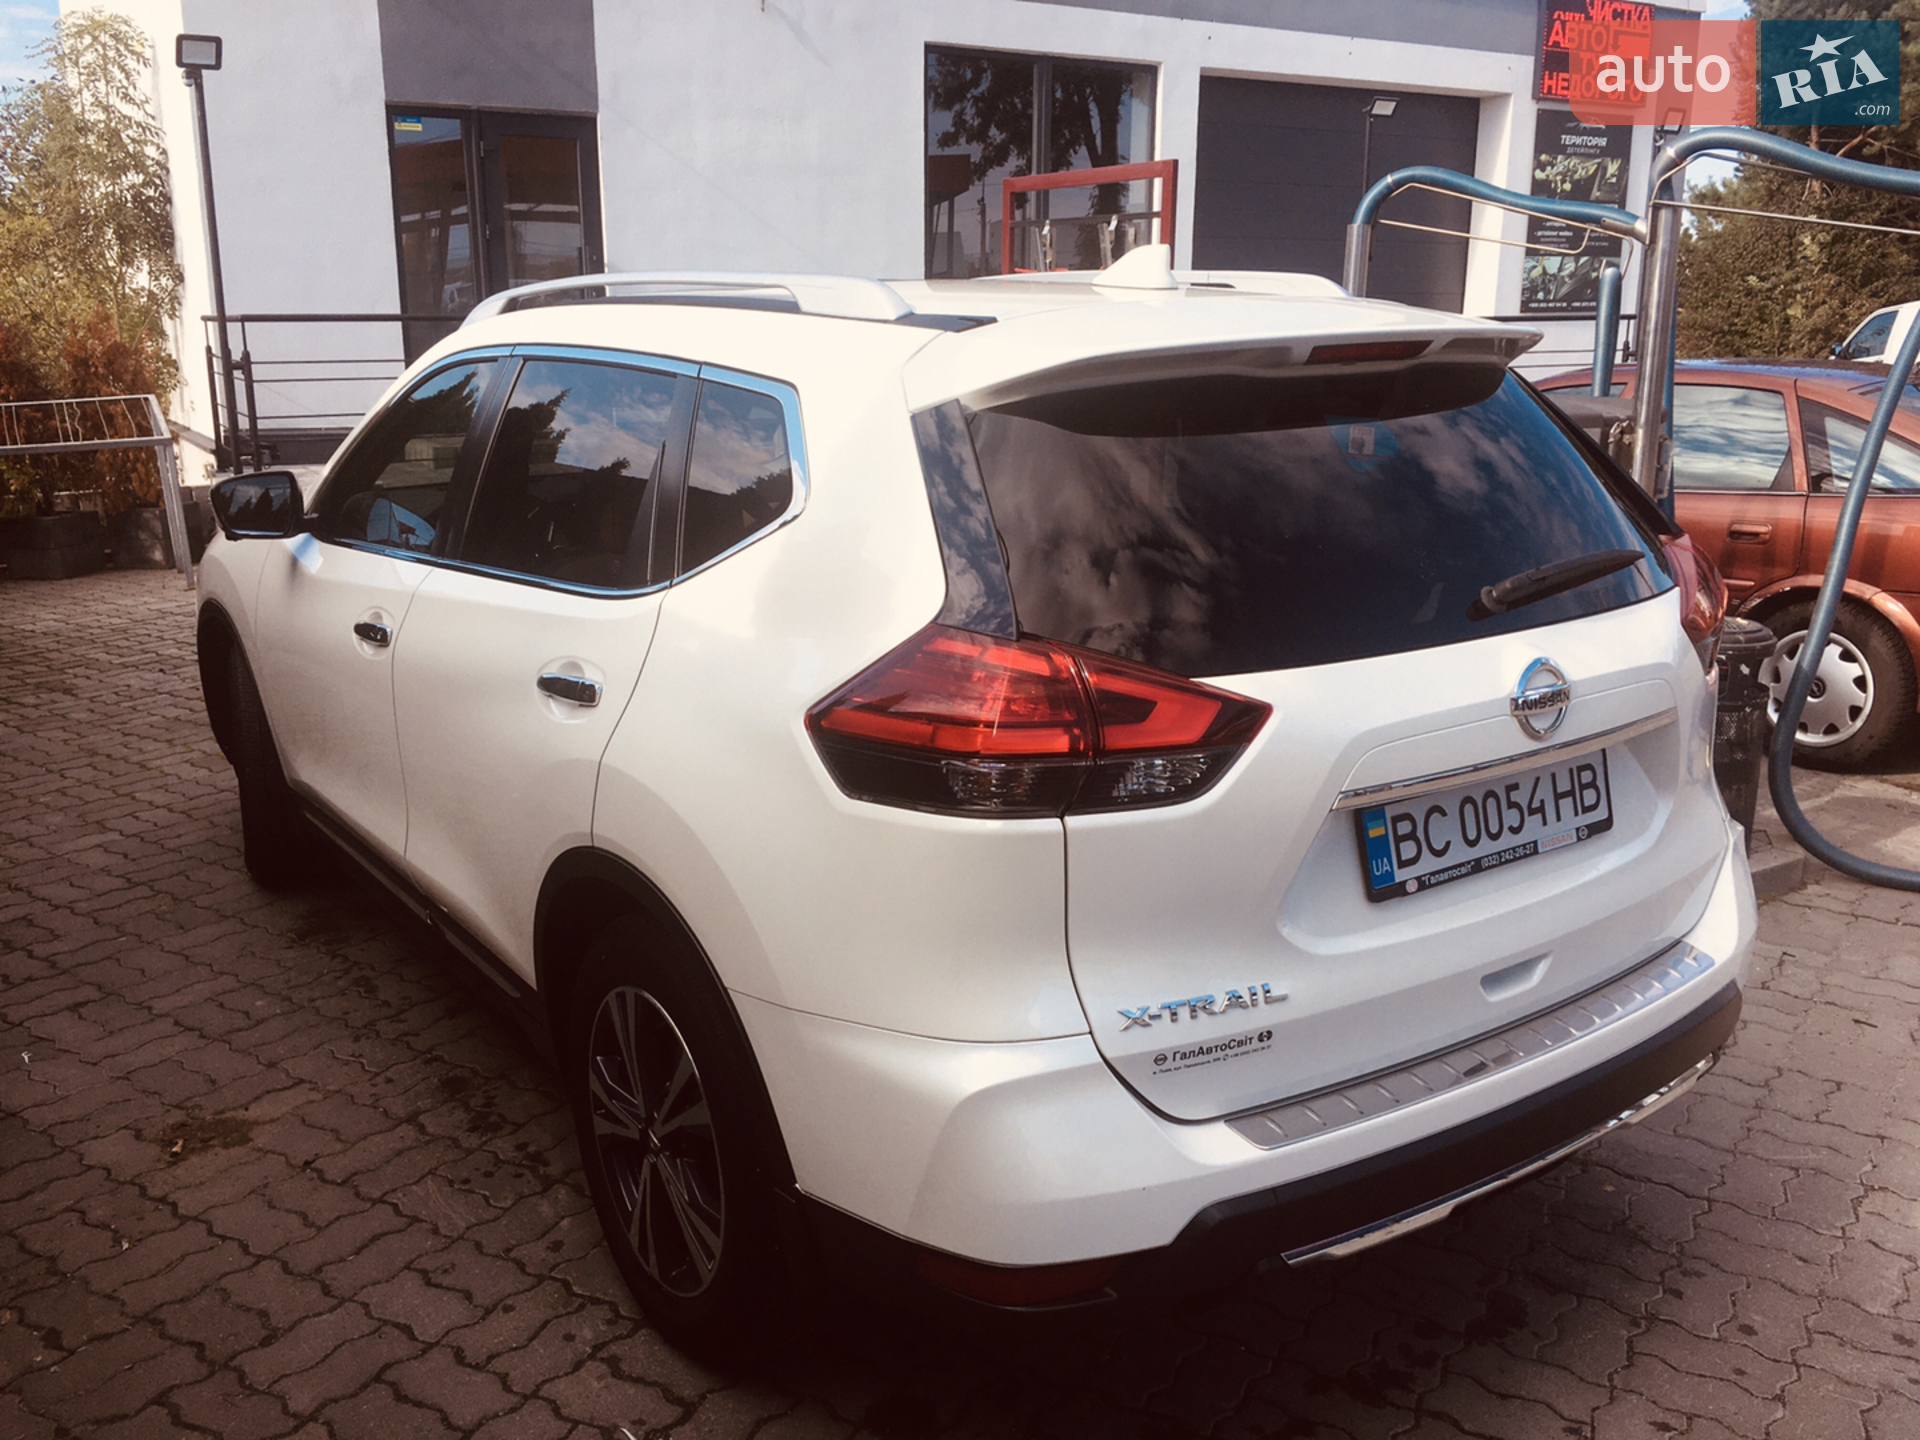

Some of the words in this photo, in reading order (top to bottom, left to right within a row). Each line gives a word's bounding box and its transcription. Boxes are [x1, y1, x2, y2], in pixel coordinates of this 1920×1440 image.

[1586, 0, 1651, 31] ЧИСТКА
[1548, 20, 1607, 51] АВТО
[1560, 134, 1608, 147] ТЕРИТОРІЯ
[1521, 689, 1570, 712] NISSAN
[1390, 804, 1452, 870] BC
[1459, 775, 1549, 848] 0054
[1551, 762, 1602, 823] HB
[1541, 832, 1574, 849] NISSAN
[1373, 860, 1392, 876] UA
[1481, 855, 1500, 869] (032)
[1117, 982, 1289, 1032] X-TRAIL
[1172, 1035, 1254, 1062] ГалАвтоСвіт
